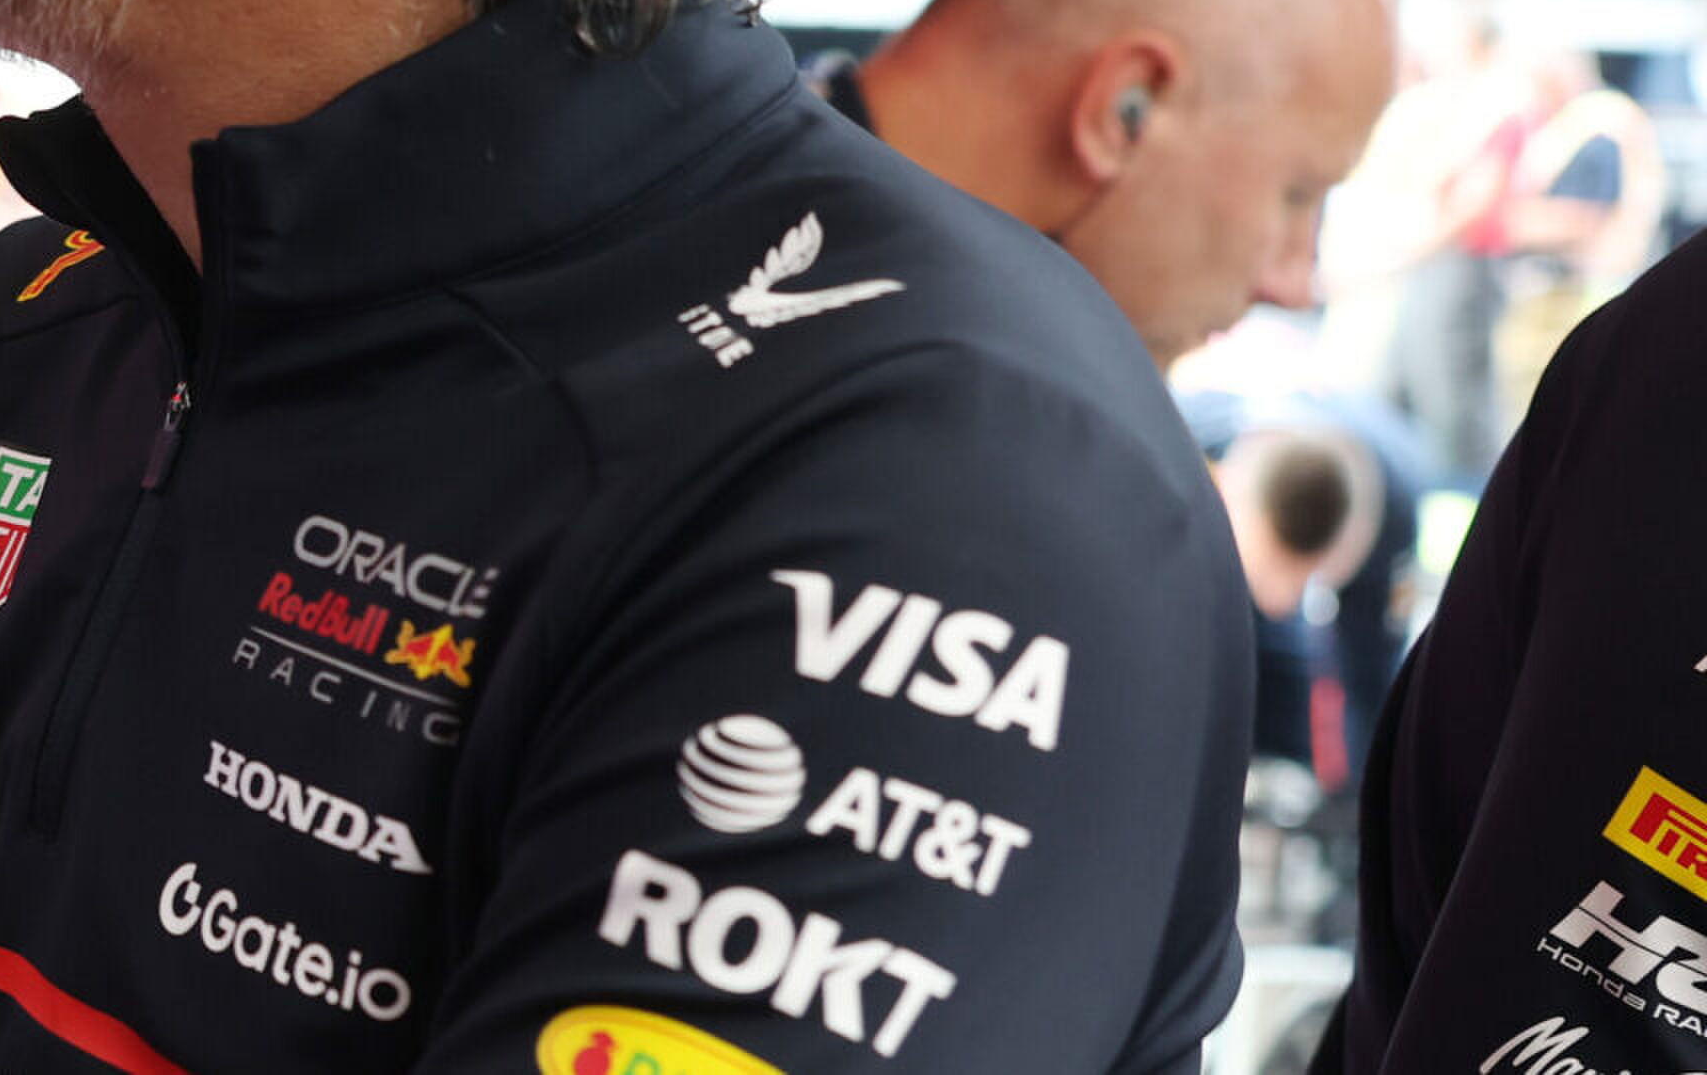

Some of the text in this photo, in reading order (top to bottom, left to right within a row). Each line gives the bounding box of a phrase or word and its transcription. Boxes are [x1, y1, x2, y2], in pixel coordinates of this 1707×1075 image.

[1, 462, 50, 513] TA
[231, 636, 463, 747] RACING
[768, 568, 1071, 752] VISA
[203, 739, 433, 875] HONDA
[805, 766, 1032, 897] AT&T
[200, 888, 412, 1021] Gate.io
[597, 849, 958, 1058] ROKT
[1536, 936, 1648, 1013] Honda
